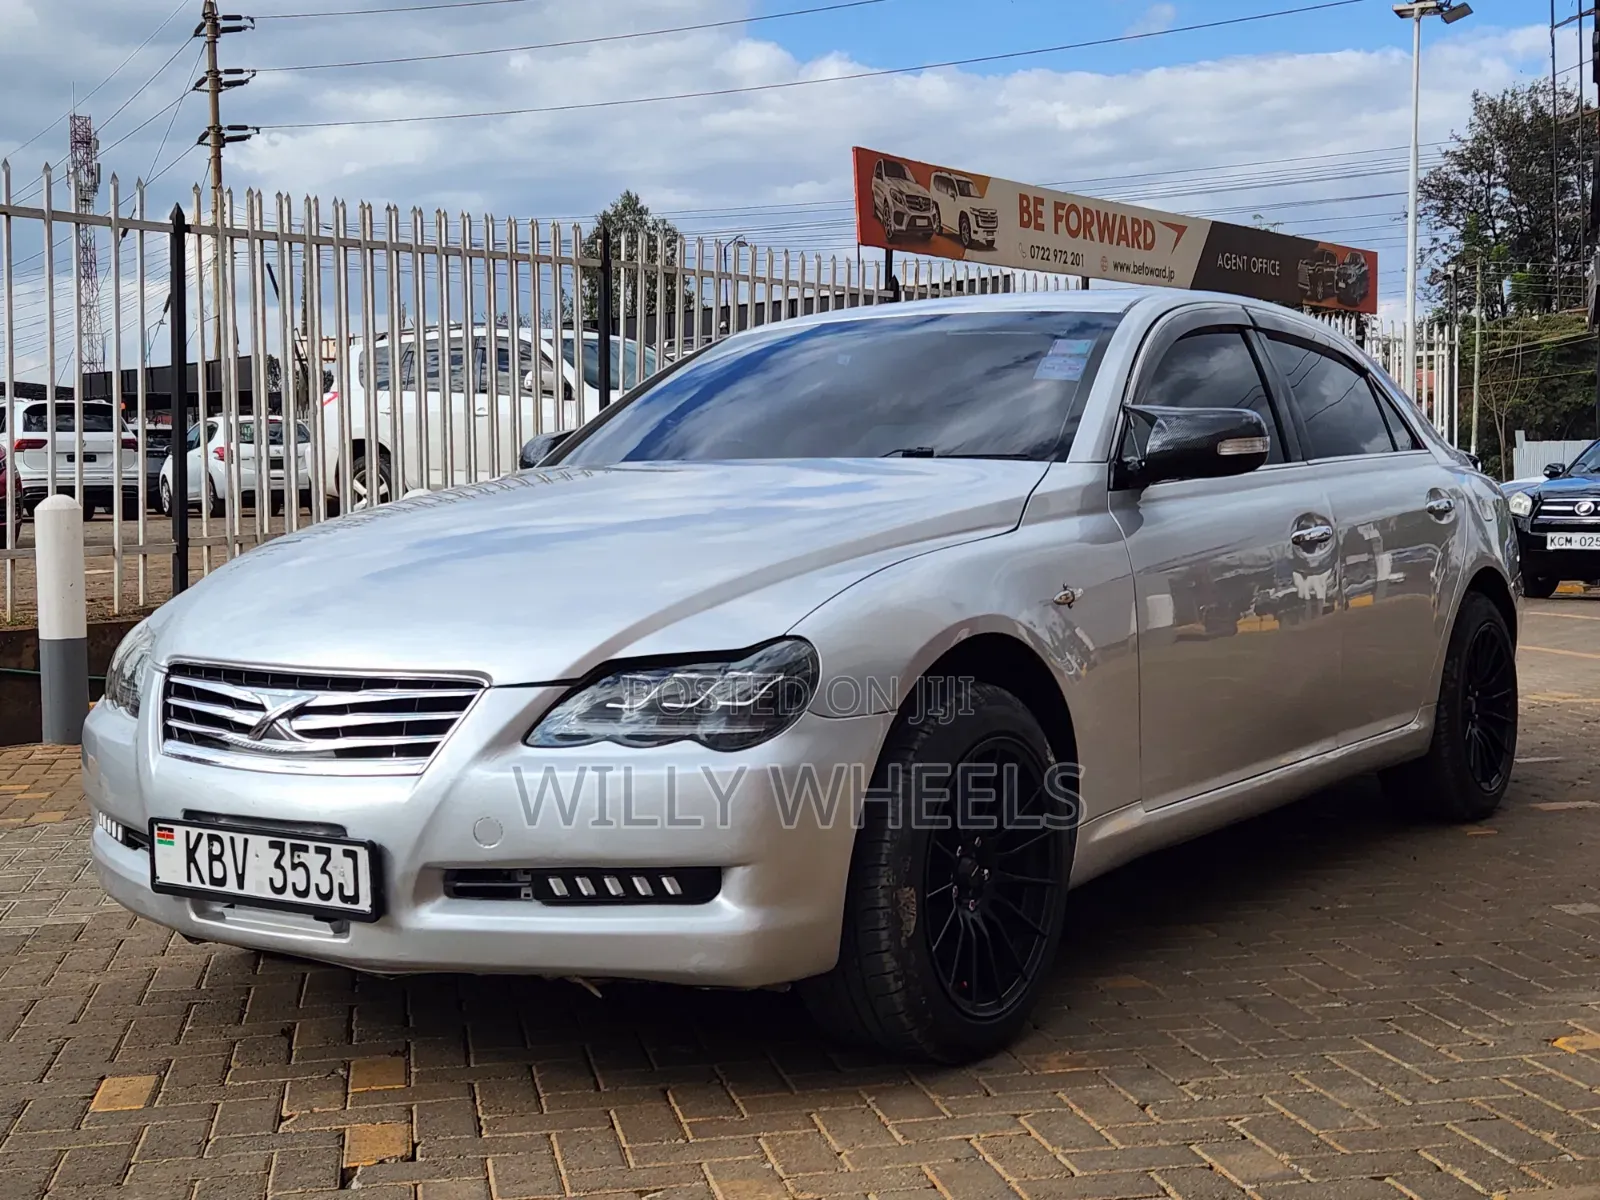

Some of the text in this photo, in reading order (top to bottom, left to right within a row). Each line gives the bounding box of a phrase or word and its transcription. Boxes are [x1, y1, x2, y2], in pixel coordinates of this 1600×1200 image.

[1019, 193, 1156, 251] BE FORWARD
[1030, 245, 1084, 267] 0722 972 201
[1217, 253, 1280, 276] AGENT OFFICE
[1112, 261, 1175, 283] www.befoward.jp
[185, 830, 360, 906] KBV 353J
